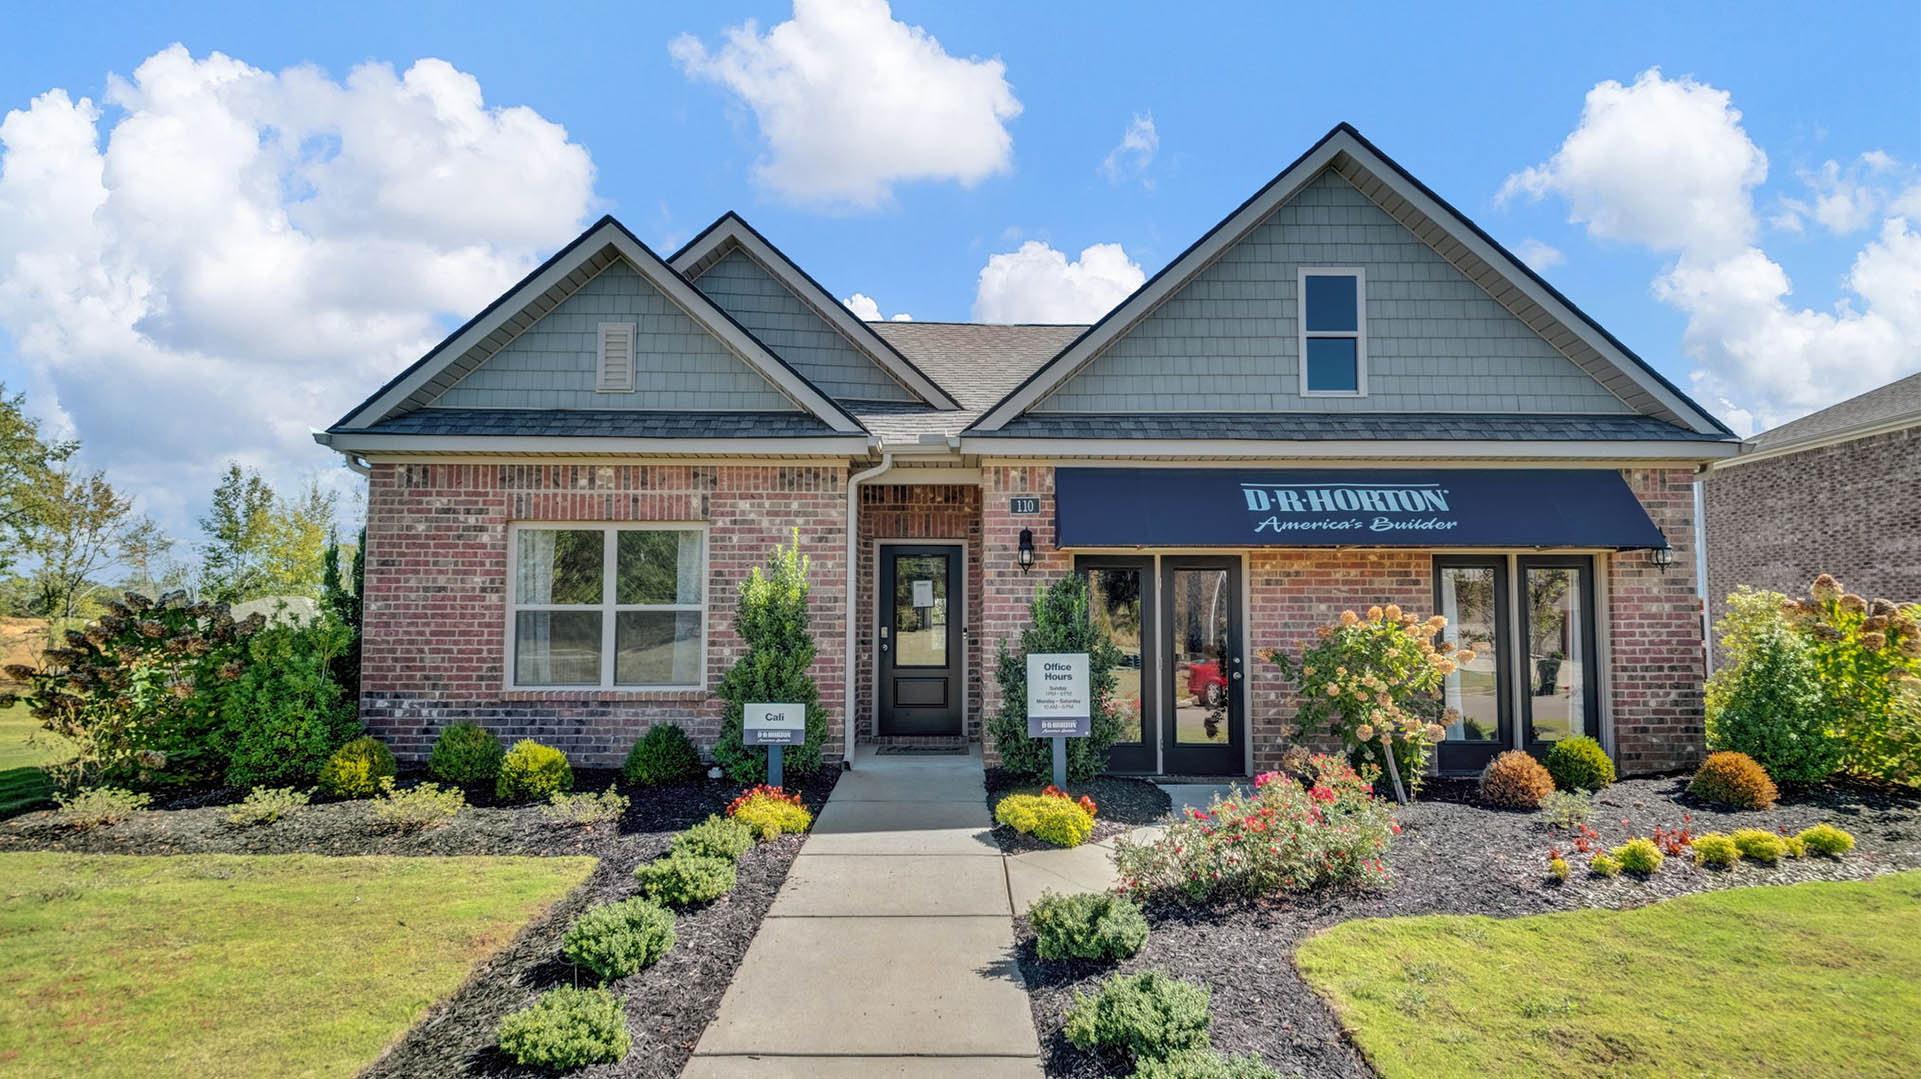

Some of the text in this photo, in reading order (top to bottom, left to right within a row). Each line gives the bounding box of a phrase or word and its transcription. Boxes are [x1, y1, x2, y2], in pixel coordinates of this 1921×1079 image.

[1017, 499, 1034, 513] 110
[1254, 516, 1458, 533] America's Builder
[1043, 662, 1072, 671] Office
[1044, 672, 1073, 681] Hours
[765, 712, 785, 722] Cali
